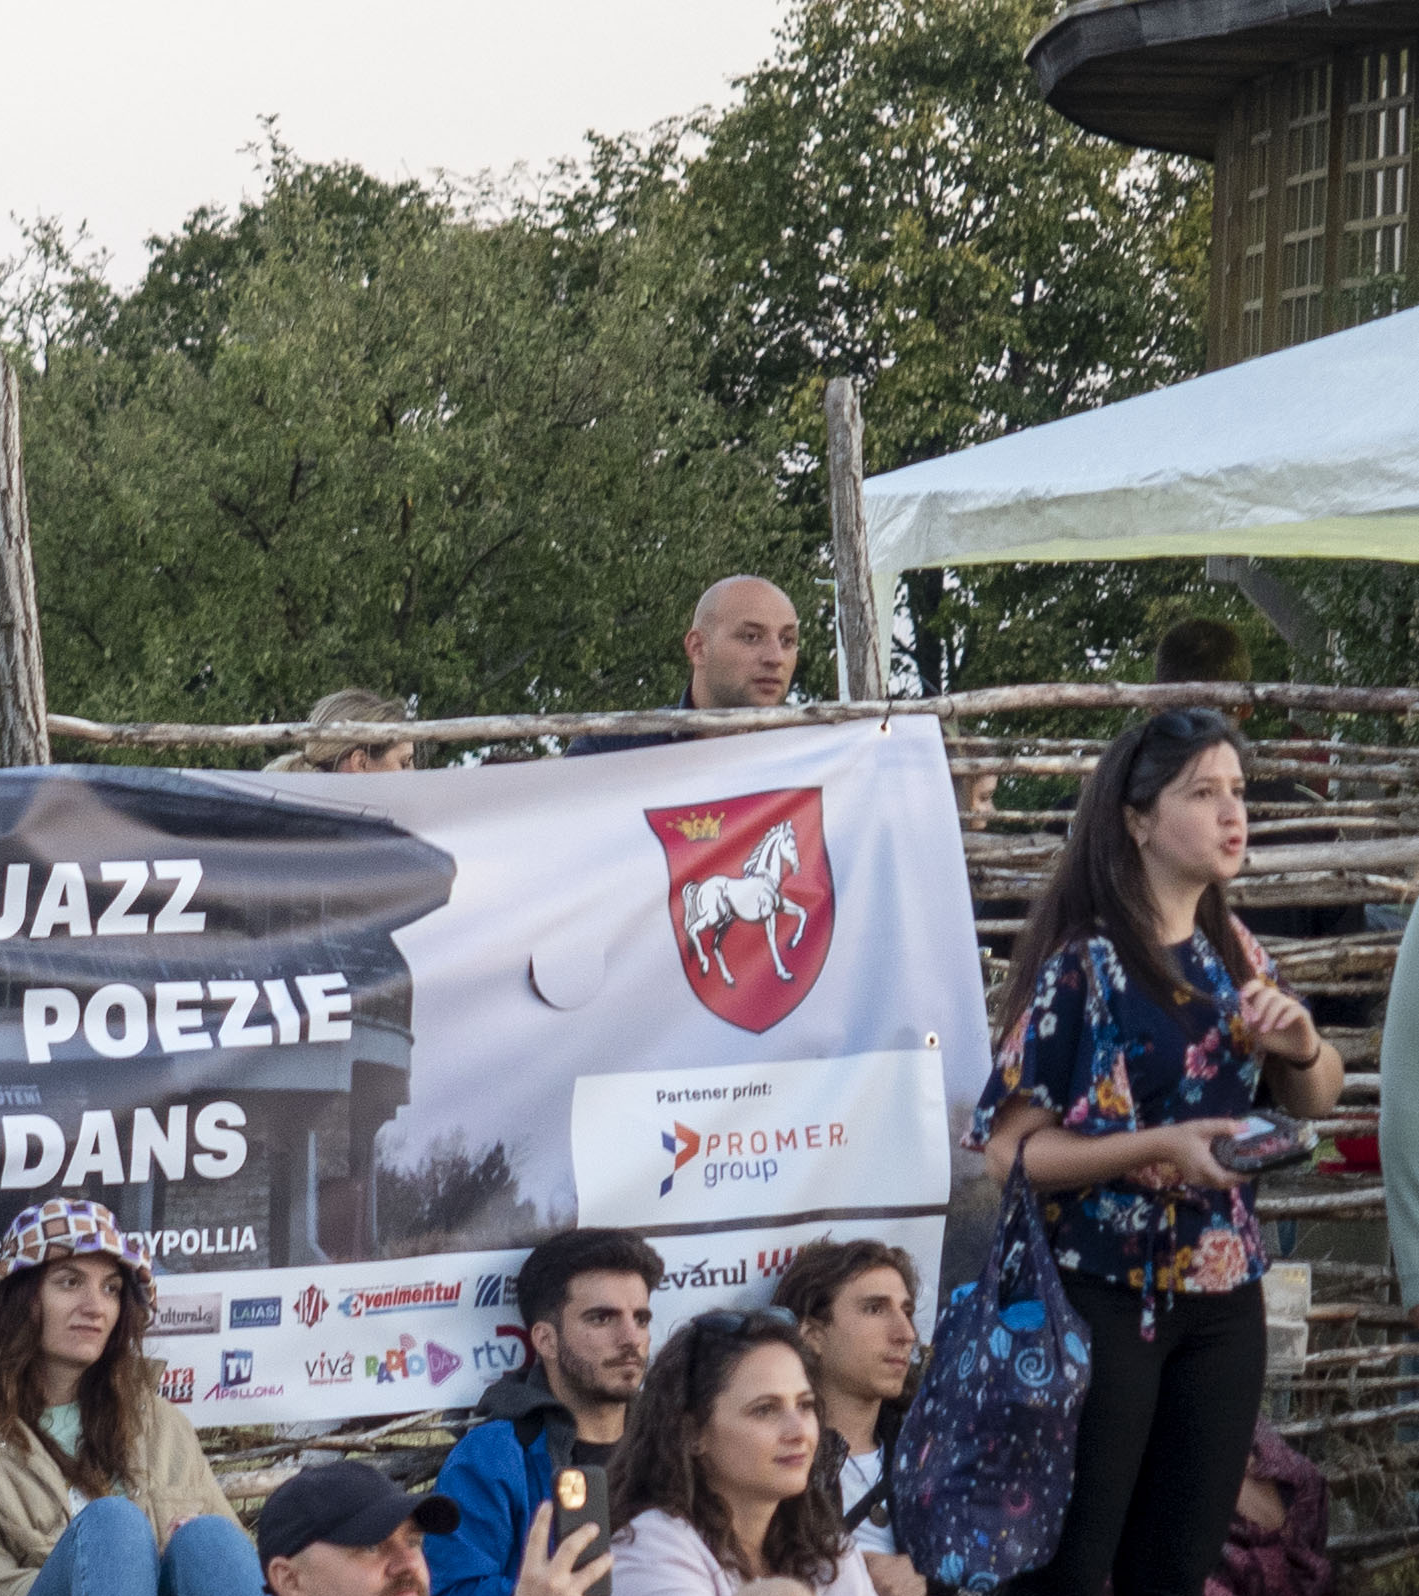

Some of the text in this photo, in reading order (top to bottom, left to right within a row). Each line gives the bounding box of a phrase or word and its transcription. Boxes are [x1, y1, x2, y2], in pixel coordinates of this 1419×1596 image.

[24, 972, 352, 1064] POEZIE
[656, 1086, 728, 1104] Partener
[0, 1101, 248, 1190] DANS
[704, 1158, 778, 1189] group
[226, 1357, 253, 1381] TV
[365, 1347, 426, 1384] RADIO
